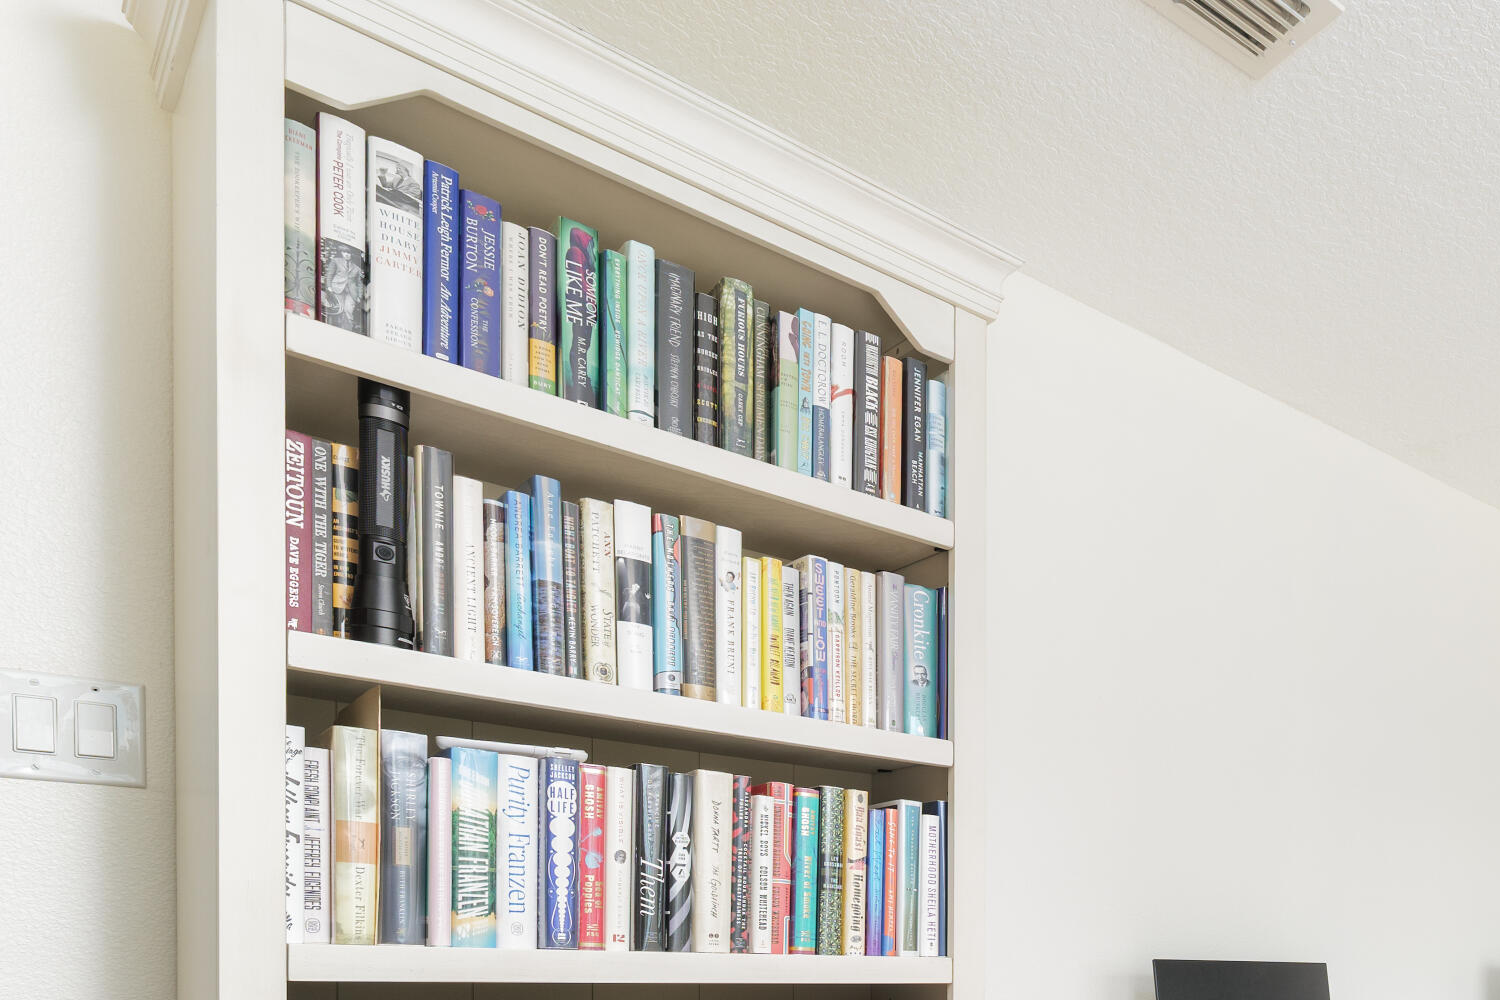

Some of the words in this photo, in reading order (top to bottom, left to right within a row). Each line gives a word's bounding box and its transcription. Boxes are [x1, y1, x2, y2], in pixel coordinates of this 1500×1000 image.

[333, 160, 343, 190] PETER
[441, 174, 452, 207] Patrick
[333, 191, 344, 217] COOK
[379, 208, 420, 231] WHITE
[379, 221, 421, 241] HOUSE
[437, 209, 452, 237] Leigh
[379, 245, 418, 264] JIMMY
[381, 232, 418, 252] DIARY
[466, 217, 478, 272] BURTON
[481, 228, 495, 271] JESSIE
[517, 232, 526, 273] JOAN
[538, 237, 547, 266] DON'T
[375, 256, 422, 279] CARTER
[441, 239, 452, 281] Fermor
[440, 283, 450, 296] An
[538, 268, 547, 294] READ
[565, 259, 583, 298] LIKE
[517, 277, 526, 330] DIDION
[538, 295, 547, 333] POETRY
[565, 299, 583, 327] ME
[586, 268, 597, 327] SOMEONE
[440, 297, 450, 350] Adventure
[470, 297, 479, 348] CONFESSION
[697, 311, 718, 326] HIGH
[737, 297, 746, 340] FURIOUS
[577, 336, 586, 354] M.R.
[737, 341, 746, 378] HOURS
[755, 306, 770, 379] CUNNINGHAM
[577, 356, 587, 388] CAREY
[914, 367, 923, 413] JENNIFER
[914, 416, 922, 442] EGAN
[314, 446, 326, 472] ONE
[380, 455, 391, 491] HUSKY
[286, 439, 304, 528] ZEITOUN
[314, 474, 327, 509] WITH
[433, 485, 444, 530] TOWNIE
[315, 512, 327, 538] THE
[289, 537, 299, 564] DAVE
[314, 540, 327, 577] TIGER
[289, 567, 299, 608] EGGERS
[815, 562, 824, 618] SWEET
[568, 616, 576, 638] KEVIN
[603, 609, 612, 638] STATE
[912, 590, 931, 659] Cronkite
[568, 640, 576, 664] BARRY
[815, 629, 825, 663] LOW
[550, 763, 575, 773] SHELLEY
[550, 772, 575, 780] JACKSON
[503, 765, 530, 824] Purity
[550, 787, 575, 800] HALF
[551, 801, 574, 814] LIFE
[584, 784, 594, 819] GHOSH
[928, 825, 937, 885] MOTHERHOOD
[458, 857, 490, 918] FRANZEN
[508, 833, 531, 914] Franzen
[639, 857, 664, 917] Them
[584, 874, 594, 914] Poppies
[927, 886, 937, 918] SHEILA
[927, 920, 936, 941] HETI
